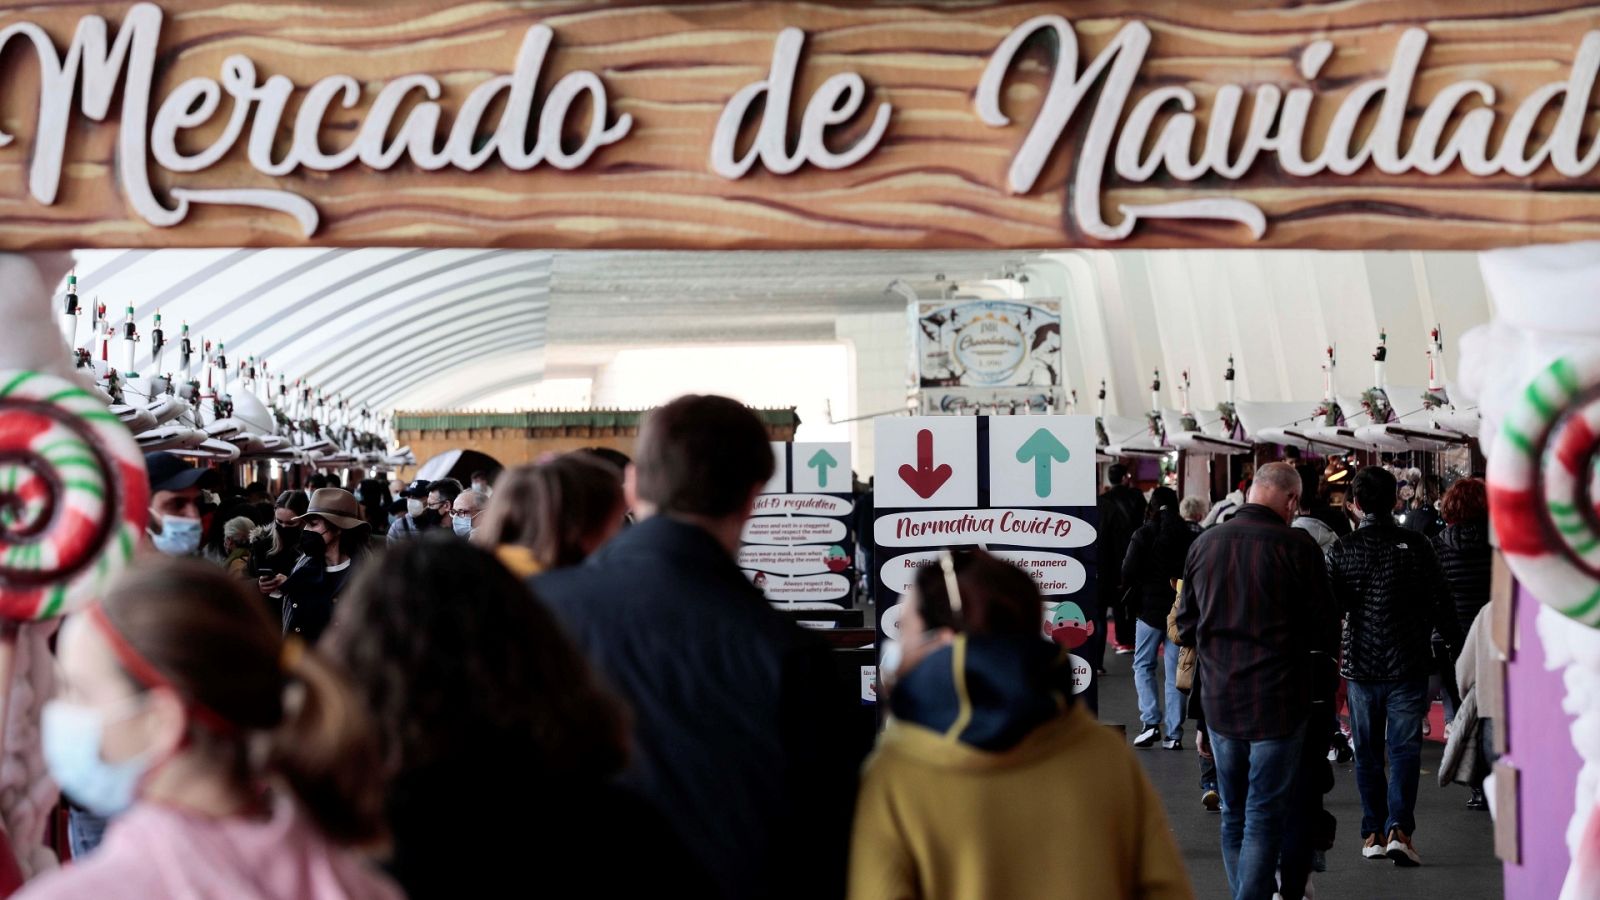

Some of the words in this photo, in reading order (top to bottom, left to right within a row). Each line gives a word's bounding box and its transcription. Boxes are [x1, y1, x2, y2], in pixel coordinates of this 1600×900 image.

[0, 2, 633, 237] Mercado
[711, 27, 892, 179] de
[975, 14, 1600, 241] Navidad
[753, 498, 780, 510] vid-19
[784, 498, 837, 511] regulation
[896, 514, 994, 539] Normativa
[1000, 511, 1072, 537] Covid-19
[904, 558, 936, 569] Realit
[1017, 558, 1029, 568] de
[1030, 560, 1067, 568] manera
[1030, 569, 1044, 578] els
[1072, 666, 1087, 675] cia
